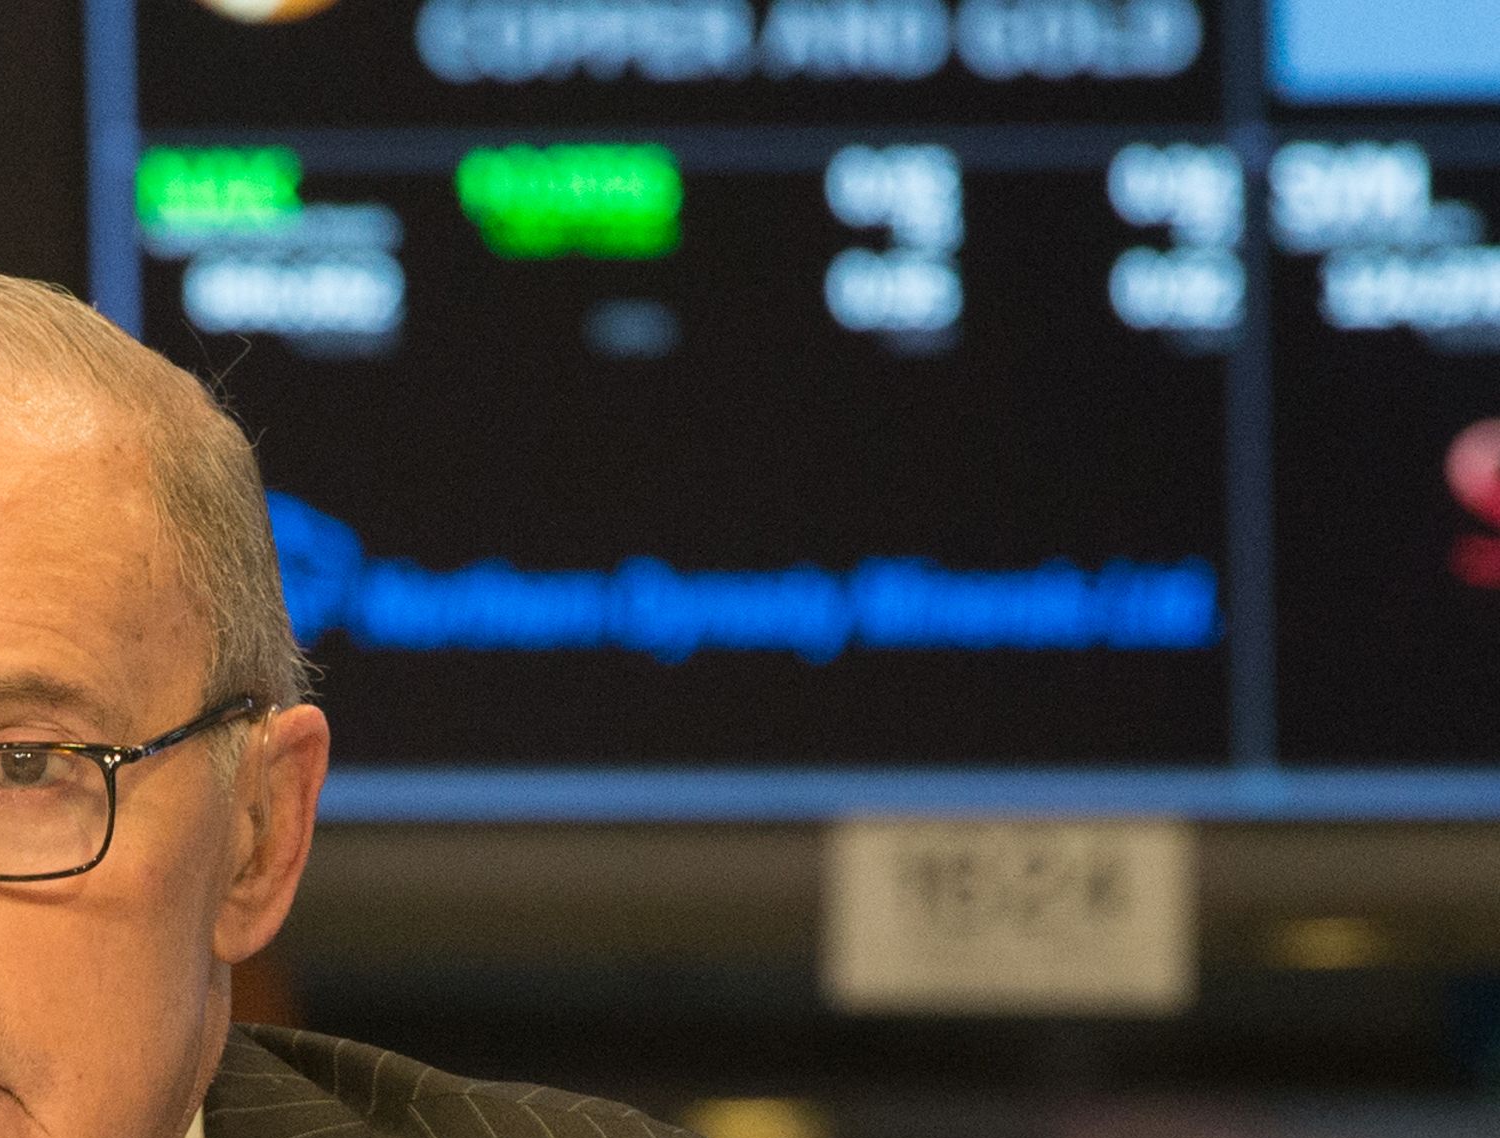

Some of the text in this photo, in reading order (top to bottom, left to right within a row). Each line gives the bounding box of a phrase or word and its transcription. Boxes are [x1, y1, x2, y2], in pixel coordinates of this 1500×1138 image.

[418, 0, 1199, 80] COPPER AND GOLD
